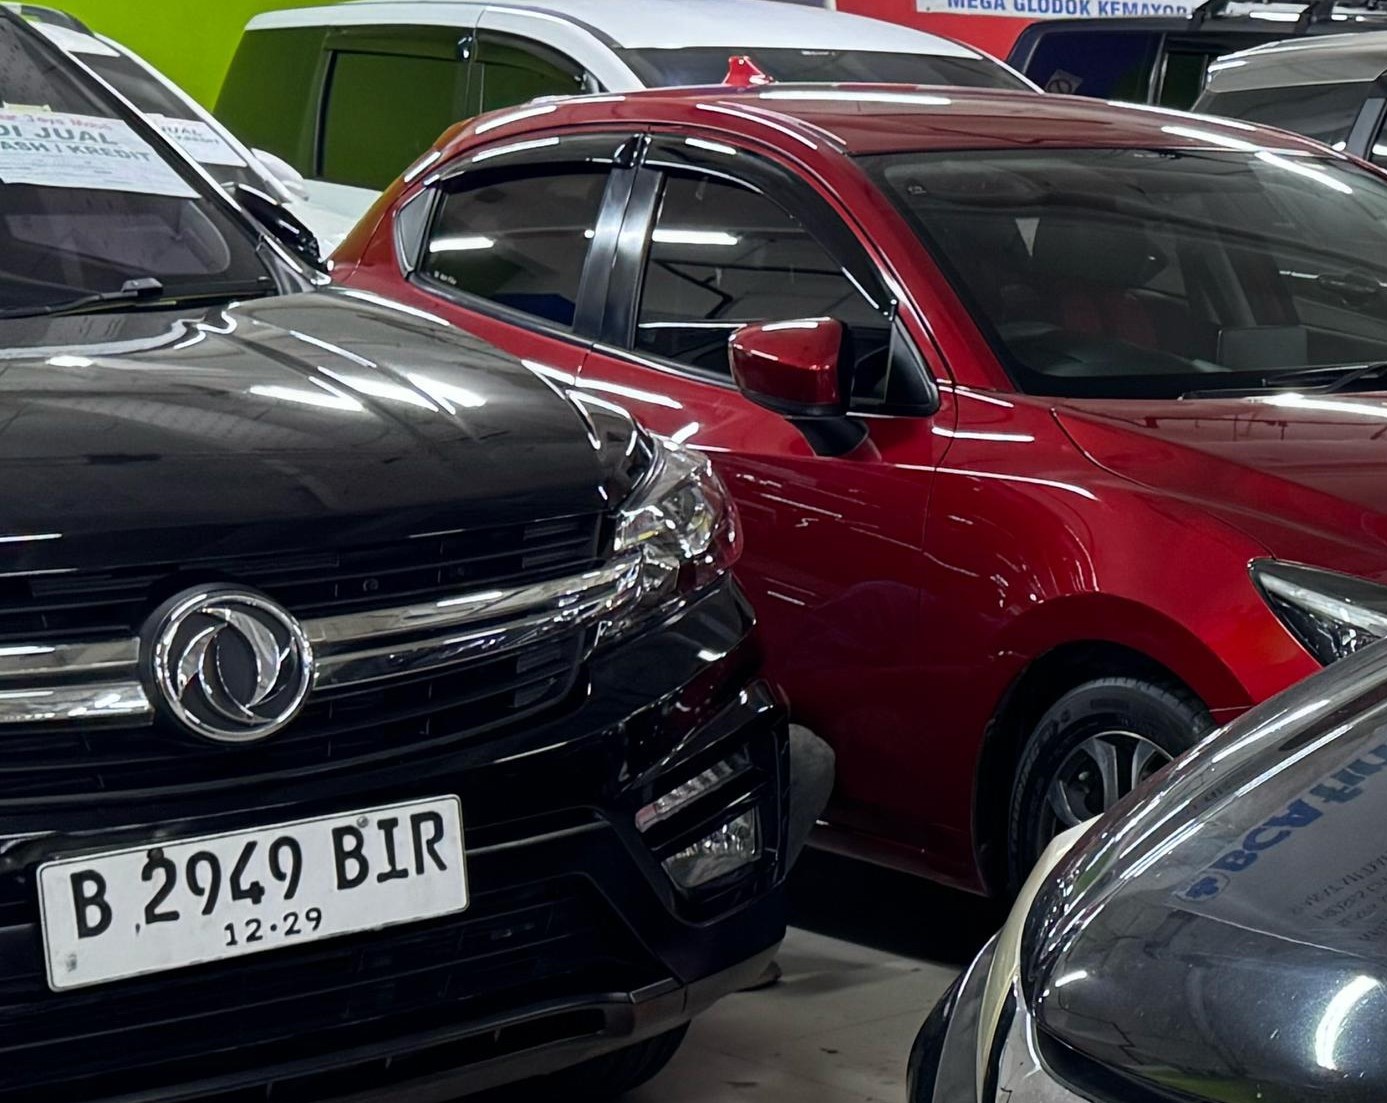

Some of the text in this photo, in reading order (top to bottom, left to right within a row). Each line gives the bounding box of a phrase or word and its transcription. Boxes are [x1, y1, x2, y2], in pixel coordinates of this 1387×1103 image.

[1014, 0, 1090, 17] GLODOK
[34, 126, 118, 146] JUAL
[66, 145, 150, 163] KREDIT
[69, 809, 449, 940] B 2949 BIR
